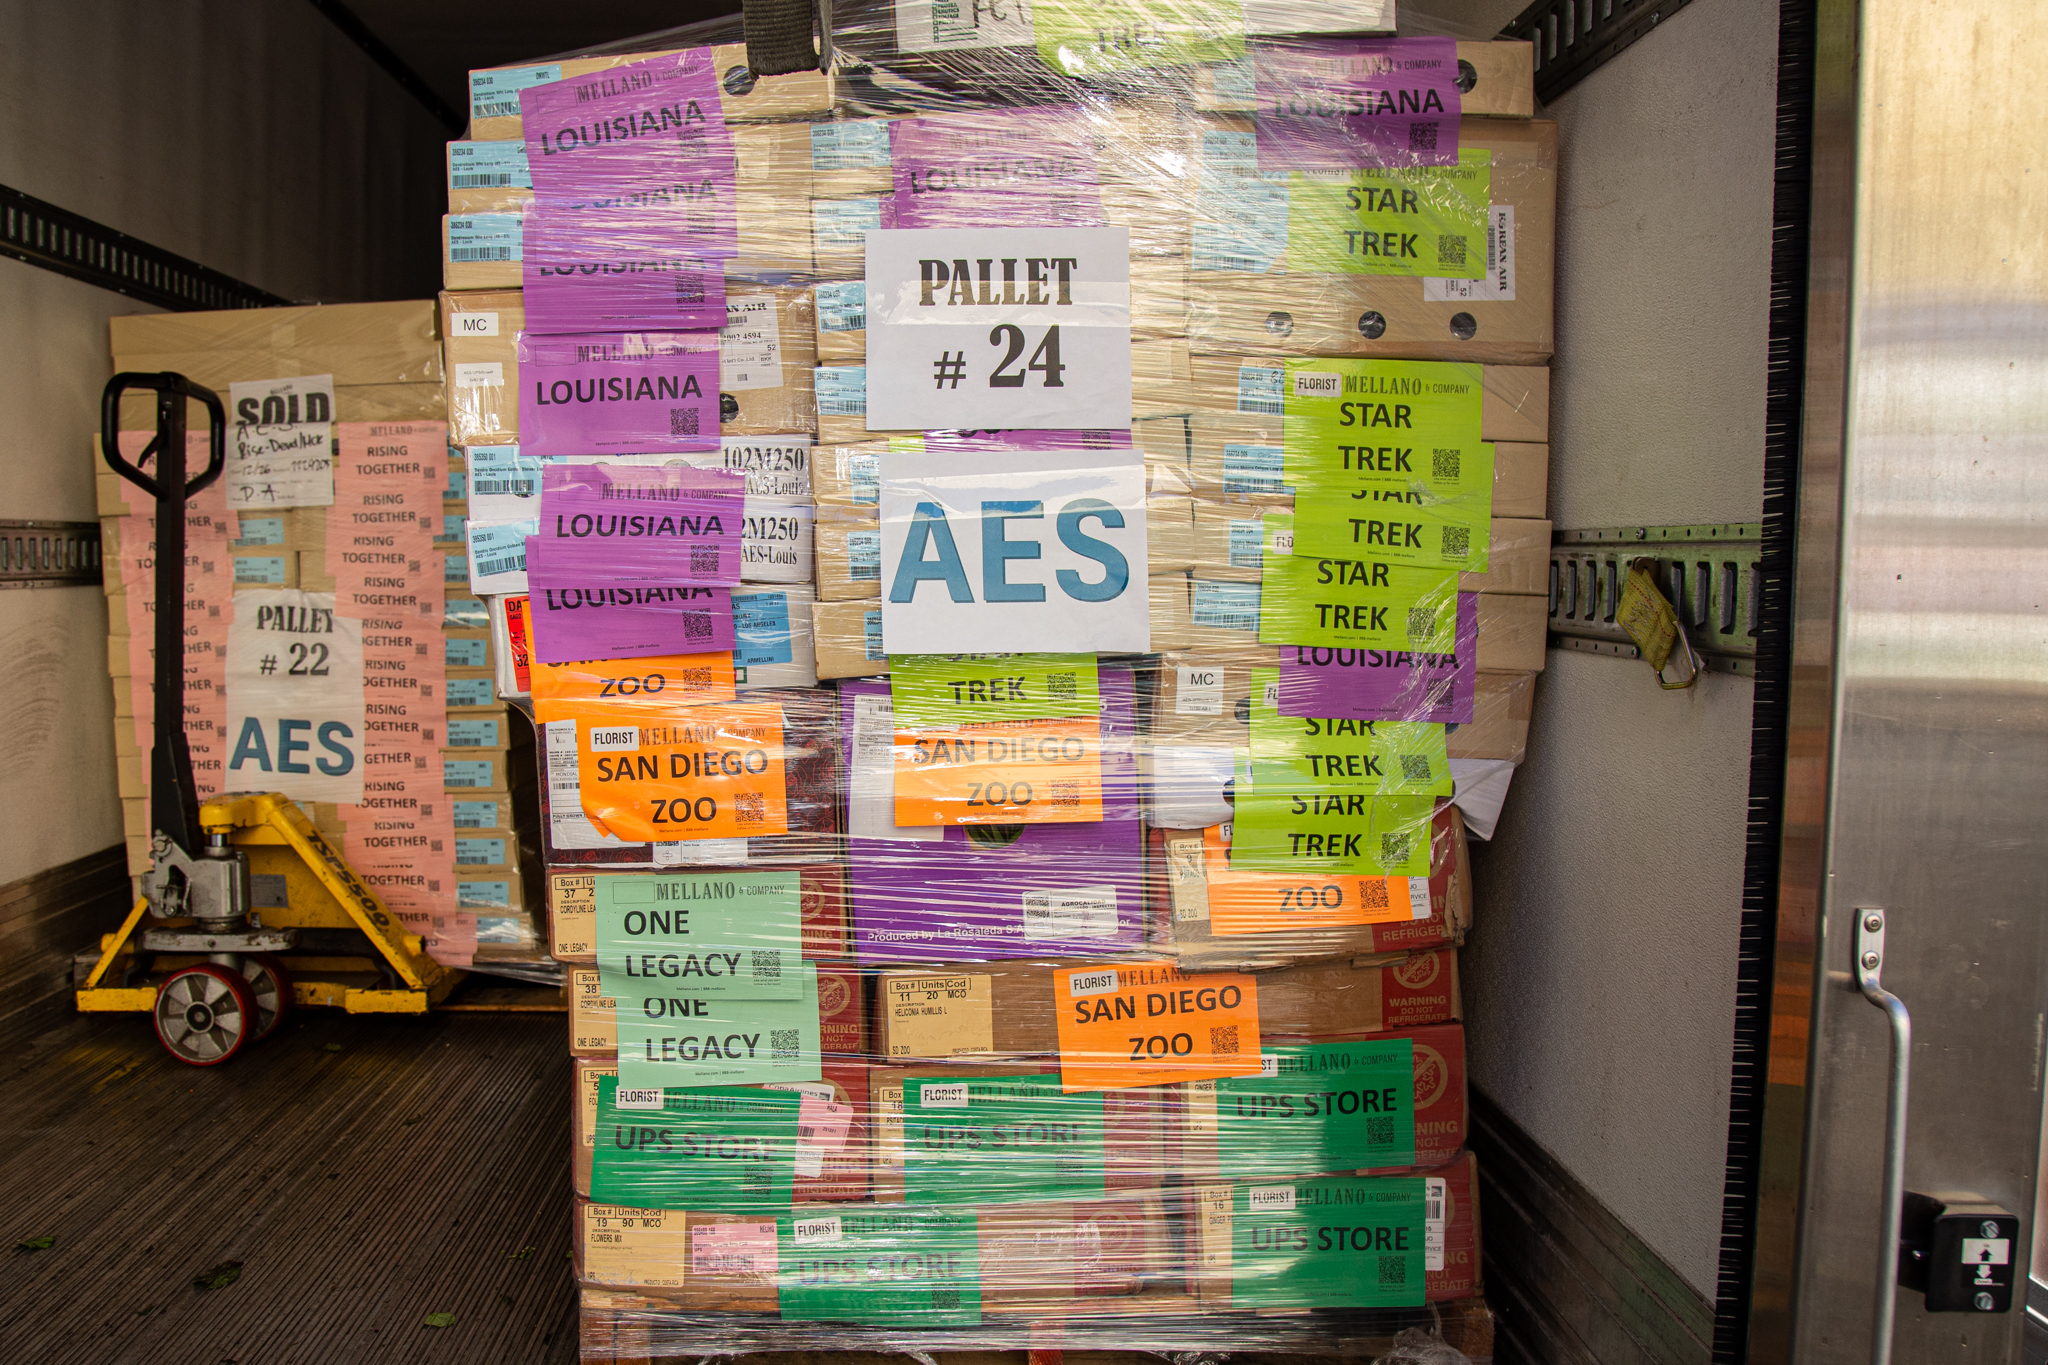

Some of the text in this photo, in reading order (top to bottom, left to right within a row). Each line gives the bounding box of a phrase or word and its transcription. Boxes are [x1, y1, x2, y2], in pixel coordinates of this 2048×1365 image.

[1404, 60, 1442, 71] COMPANY
[577, 65, 699, 104] MELLANO COMPANY
[1275, 89, 1444, 118] LOUISIANA
[542, 100, 706, 155] LOUISIANA
[911, 160, 1075, 193] LOUISIANA
[1346, 186, 1418, 214] STAR
[1343, 231, 1418, 258] TREK
[918, 258, 1078, 306] PALLET
[1499, 266, 1507, 291] AIR
[743, 303, 767, 312] AIR
[463, 319, 487, 331] MC
[743, 332, 762, 340] 4594
[578, 343, 654, 363] MELLANO
[933, 324, 1066, 389] # 24
[537, 374, 703, 405] LOUISIANA
[1298, 377, 1337, 391] FLORIST
[1346, 375, 1421, 396] MELLANO
[1432, 384, 1470, 395] COMPANY
[237, 392, 331, 426] SOLD
[1339, 402, 1412, 428] STAR
[367, 445, 408, 457] RISING
[724, 446, 804, 472] 102M250
[1338, 446, 1413, 473] TREK
[356, 463, 420, 475] TOGETHER
[363, 494, 404, 505] RISING
[602, 482, 730, 501] MELLANO COMPANY
[352, 511, 416, 523] TOGETHER
[556, 513, 725, 538] LOUISIANA
[354, 536, 394, 546] RISING
[1348, 518, 1423, 548] TREK
[342, 552, 406, 564] TOGETHER
[740, 547, 797, 565] AES-Louis
[888, 498, 1130, 603] AES
[364, 577, 405, 588] RISING
[1316, 559, 1389, 587] STAR
[353, 594, 417, 606] TOGETHER
[256, 605, 334, 634] PALLET
[362, 619, 403, 630] RISING
[742, 621, 752, 629] LOS
[1315, 603, 1388, 631] TREK
[260, 642, 329, 676] # 22
[365, 660, 406, 671] RISING
[517, 653, 529, 667] 52
[1297, 647, 1460, 669] LOUISIANA
[363, 676, 418, 688] OGETHER
[600, 674, 666, 699] ZOO
[1190, 673, 1214, 685] MC
[947, 676, 1026, 705] TREK
[366, 704, 407, 715] RISING
[364, 721, 419, 732] OGETHER
[594, 725, 716, 746] FLORIST MELLANO
[1305, 717, 1376, 737] STAR
[229, 716, 354, 777] AES
[914, 737, 1085, 764] SAN DIEGO
[597, 749, 768, 782] SAN DIEGO
[1305, 754, 1384, 777] TREK
[365, 781, 405, 791] RISING
[967, 781, 1033, 807] ZOO
[651, 797, 717, 824] ZOO
[1291, 795, 1365, 816] STAR
[363, 836, 427, 848] TOGETHER
[1287, 833, 1361, 857] TREK
[361, 875, 425, 885] TOGETHER
[560, 879, 574, 887] Box
[564, 889, 576, 898] 37
[656, 881, 736, 901] MELLANO
[746, 884, 785, 897] COMPANY
[1277, 884, 1343, 912] ZOO
[560, 905, 587, 914] CORDYLINE
[624, 910, 690, 935] ONE
[868, 925, 1003, 942] Produced by La Rosaleda
[559, 943, 588, 953] ONE LEGACY
[626, 952, 742, 978] LEGACY
[896, 980, 966, 990] Box Units Cod
[1074, 965, 1192, 990] FLORIST MELLANO
[585, 985, 597, 993] 38
[900, 990, 967, 1001] 11 20 MCO
[643, 997, 709, 1019] ONE
[1075, 985, 1242, 1024] SAN DIEGO
[1389, 995, 1447, 1008] WARNING
[895, 1007, 942, 1017] HELICONIA HUMILLIS
[1388, 1013, 1447, 1024] REFRIGERATE
[577, 1037, 607, 1047] ONE LEGACY
[646, 1033, 761, 1062] LEGACY
[900, 1046, 911, 1055] ZOO
[1130, 1033, 1194, 1061] ZOO
[1277, 1053, 1351, 1073] MELLANO
[1361, 1054, 1398, 1066] COMPANY
[620, 1090, 659, 1102] FLORIST
[888, 1091, 902, 1099] Box
[924, 1088, 962, 1101] FLORIST
[1237, 1088, 1397, 1119] UPS STORE
[615, 1125, 778, 1162] UPS STORE
[924, 1122, 1086, 1149] UPS STORE
[1416, 1137, 1440, 1147] NOT
[1209, 1190, 1221, 1199] Box
[1253, 1191, 1290, 1205] FLORIST
[1376, 1192, 1411, 1203] COMPANY
[593, 1208, 607, 1216] Box
[618, 1208, 640, 1216] Units
[1213, 1202, 1224, 1210] 16
[596, 1219, 661, 1228] 19 90 MCO
[798, 1222, 836, 1237] FLORIST
[1209, 1215, 1227, 1225] GINGER
[591, 1234, 622, 1243] FLOWERS MIX
[1251, 1226, 1409, 1251] UPS STORE
[799, 1252, 962, 1285] UPS STORE
[1426, 1268, 1450, 1280] NOT
